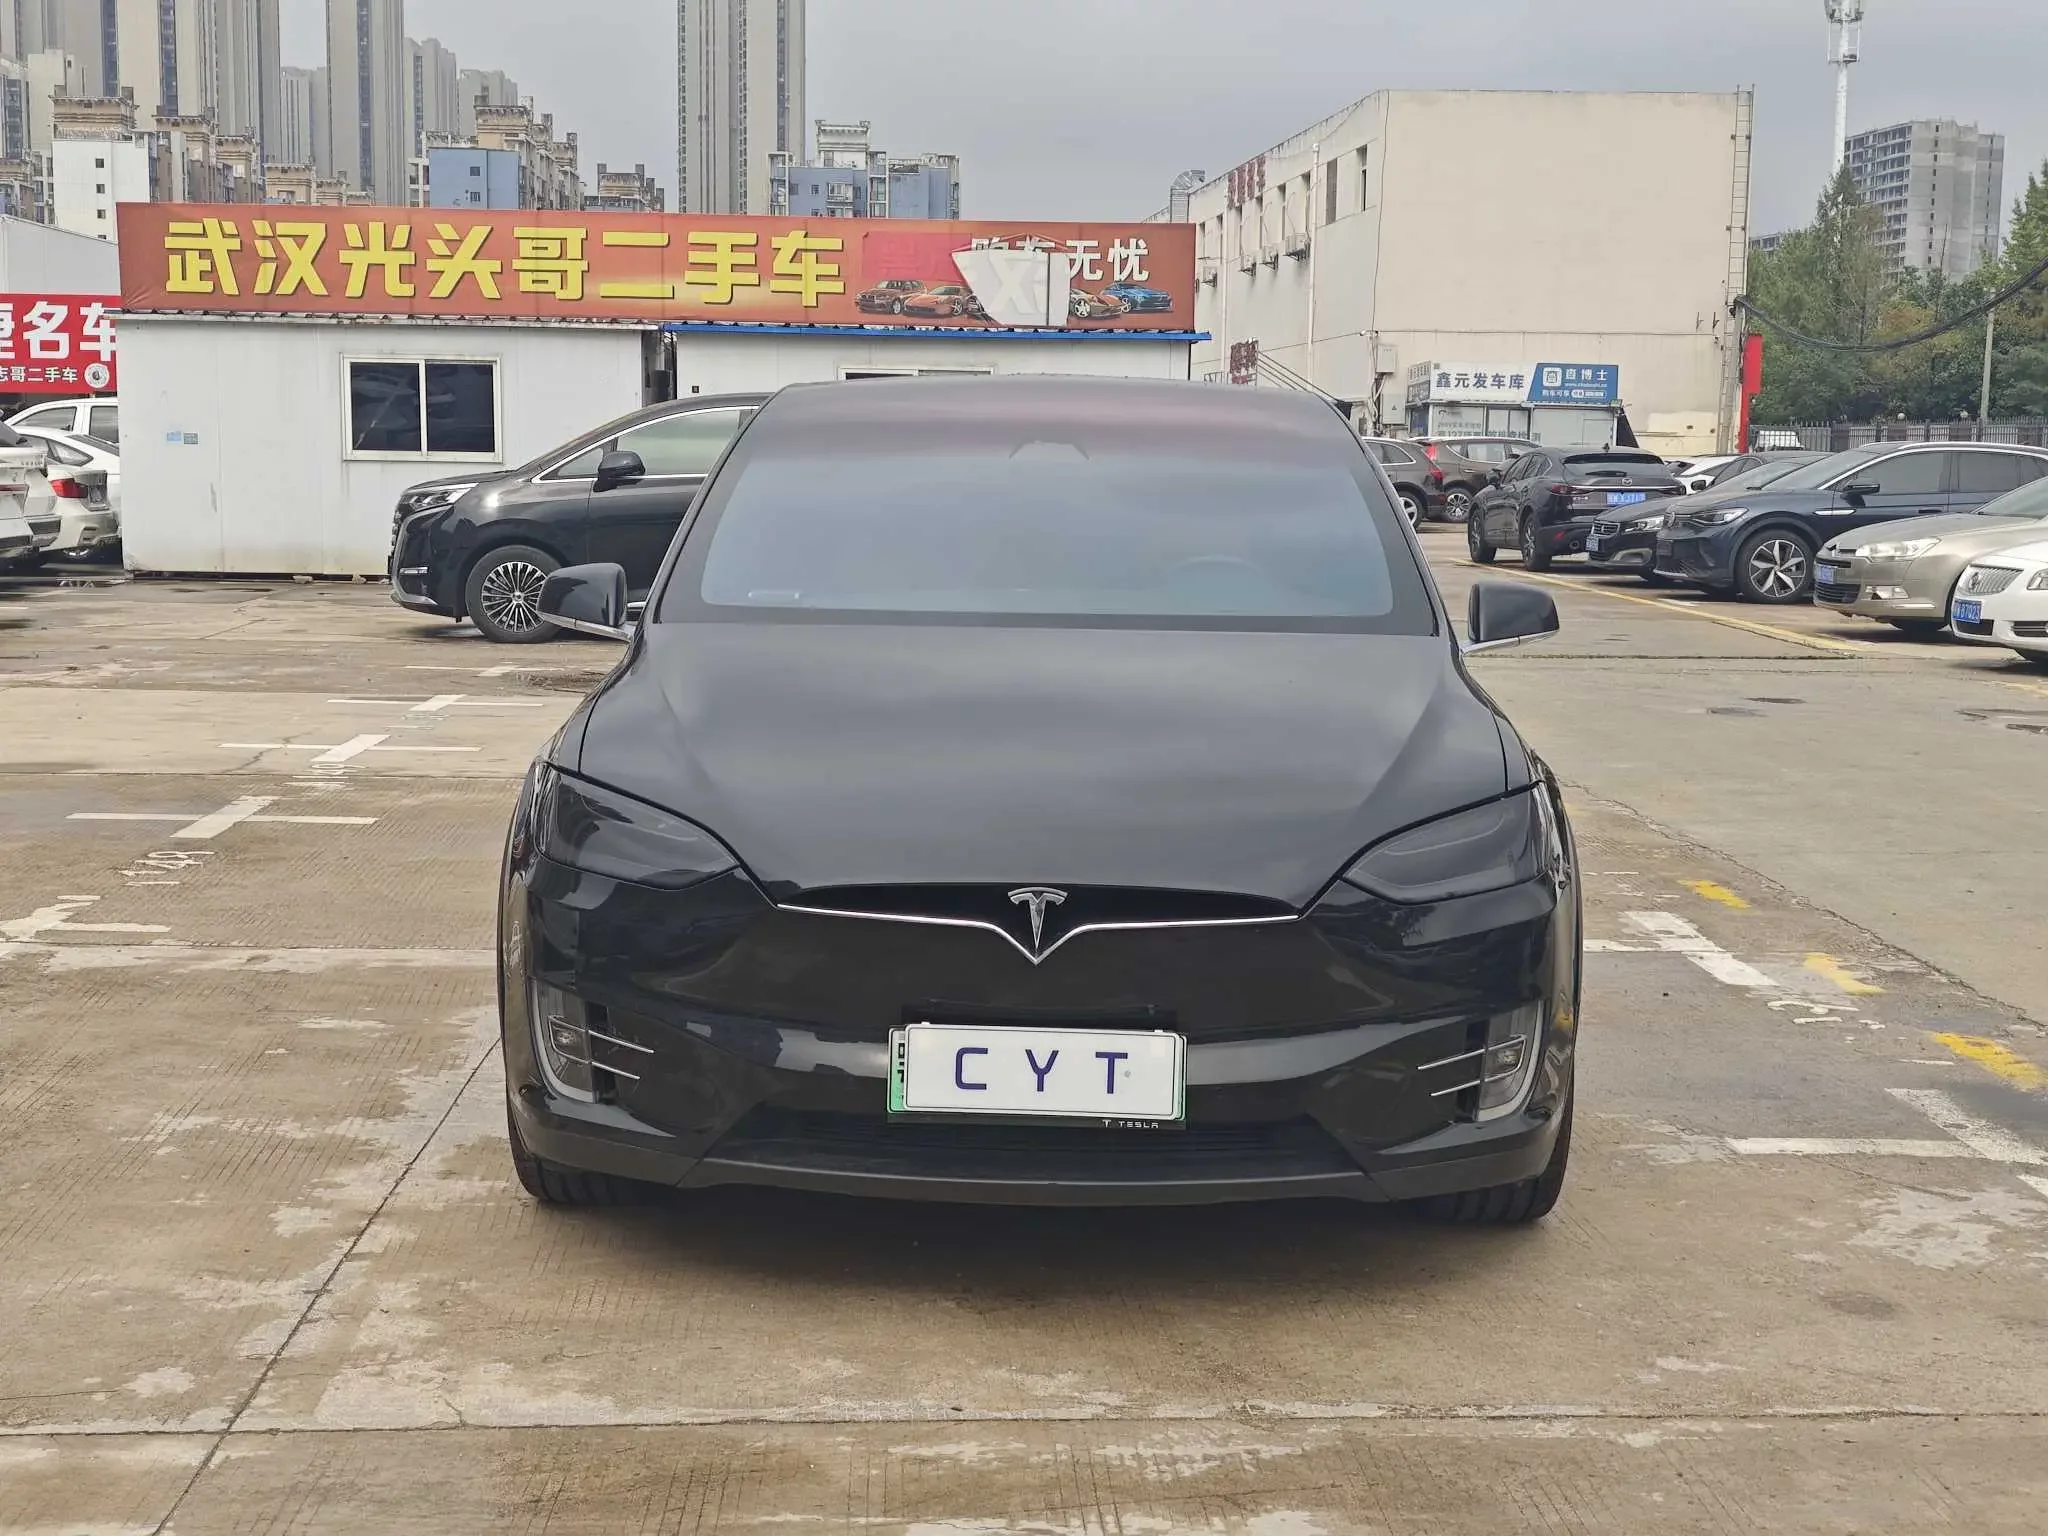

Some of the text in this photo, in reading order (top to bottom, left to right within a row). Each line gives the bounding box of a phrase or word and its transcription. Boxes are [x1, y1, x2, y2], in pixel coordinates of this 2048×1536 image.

[164, 218, 846, 307] 武汉光头哥二手车
[1435, 371, 1525, 390] 鑫元发车库
[1118, 1121, 1159, 1129] TESLA
